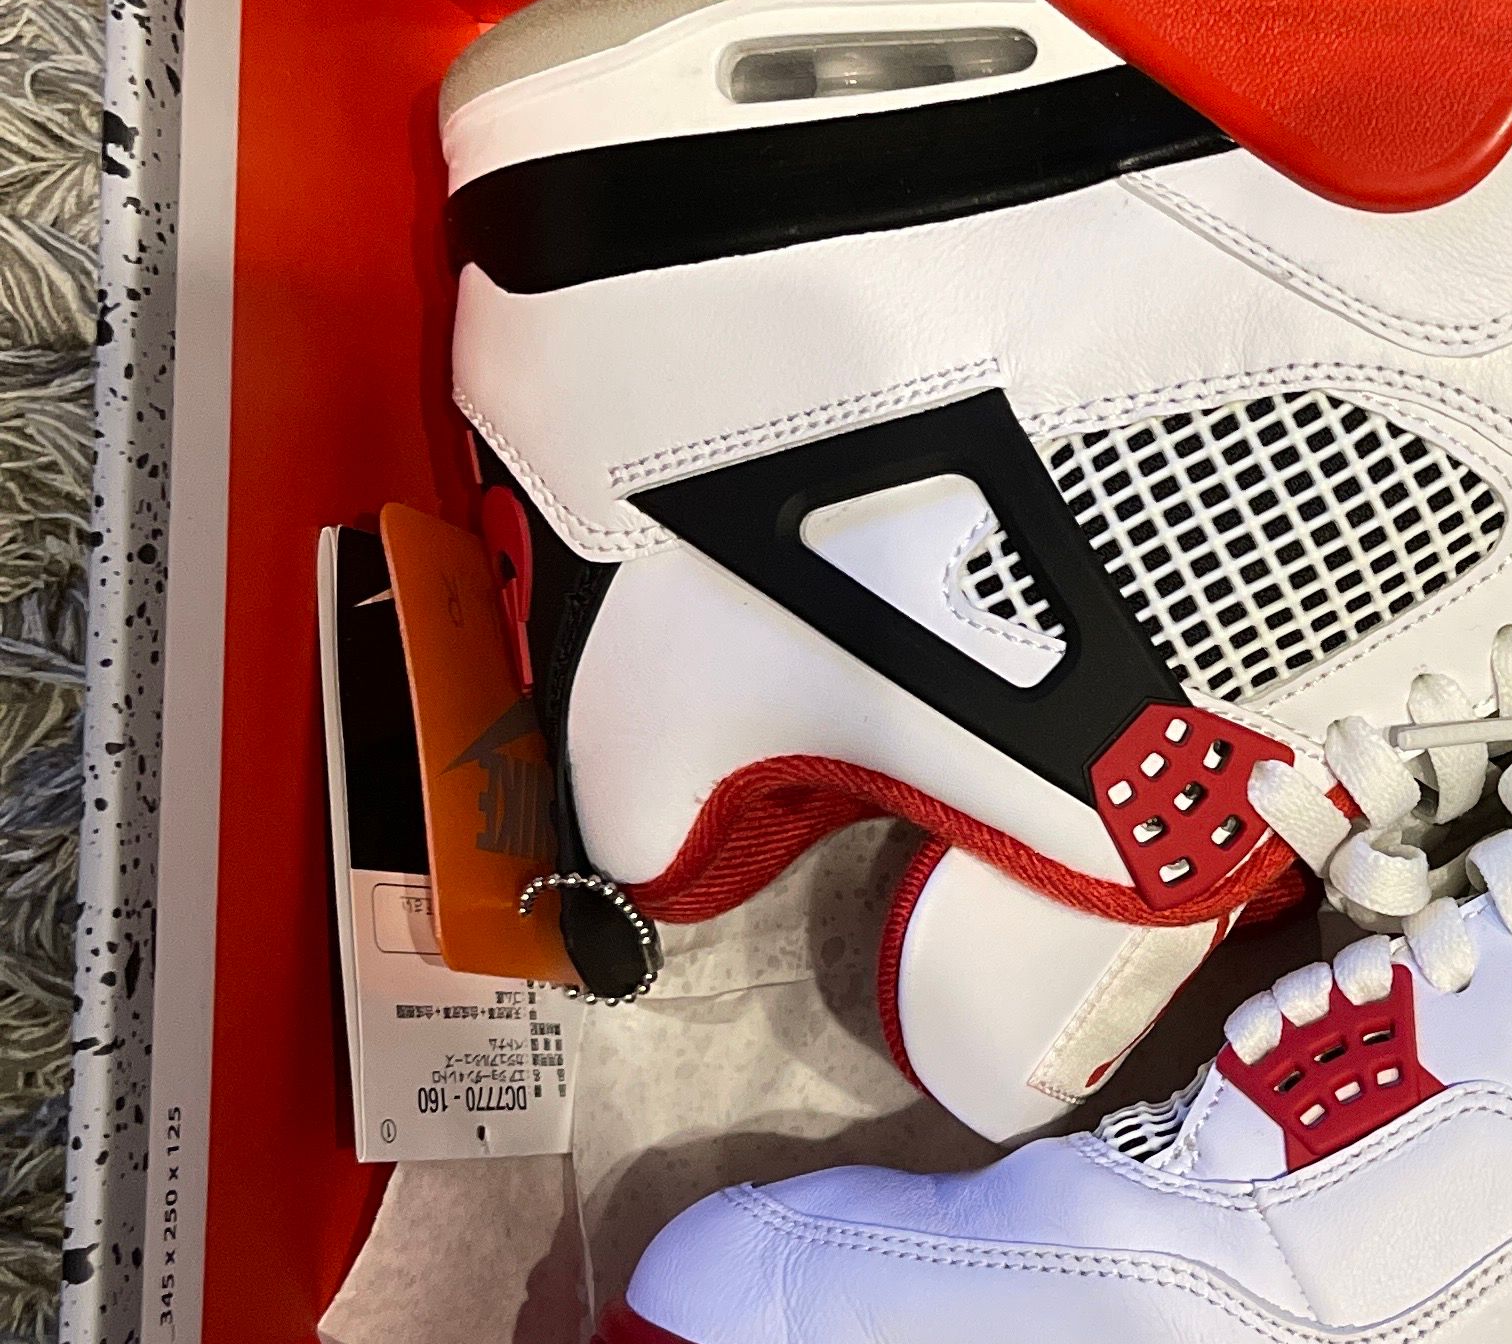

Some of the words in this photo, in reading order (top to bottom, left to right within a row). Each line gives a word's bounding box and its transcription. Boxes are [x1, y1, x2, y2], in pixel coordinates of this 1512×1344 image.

[417, 1087, 449, 1114] 160
[466, 1086, 527, 1111] DC7770
[167, 1106, 181, 1156] 125
[163, 1189, 178, 1242] 250
